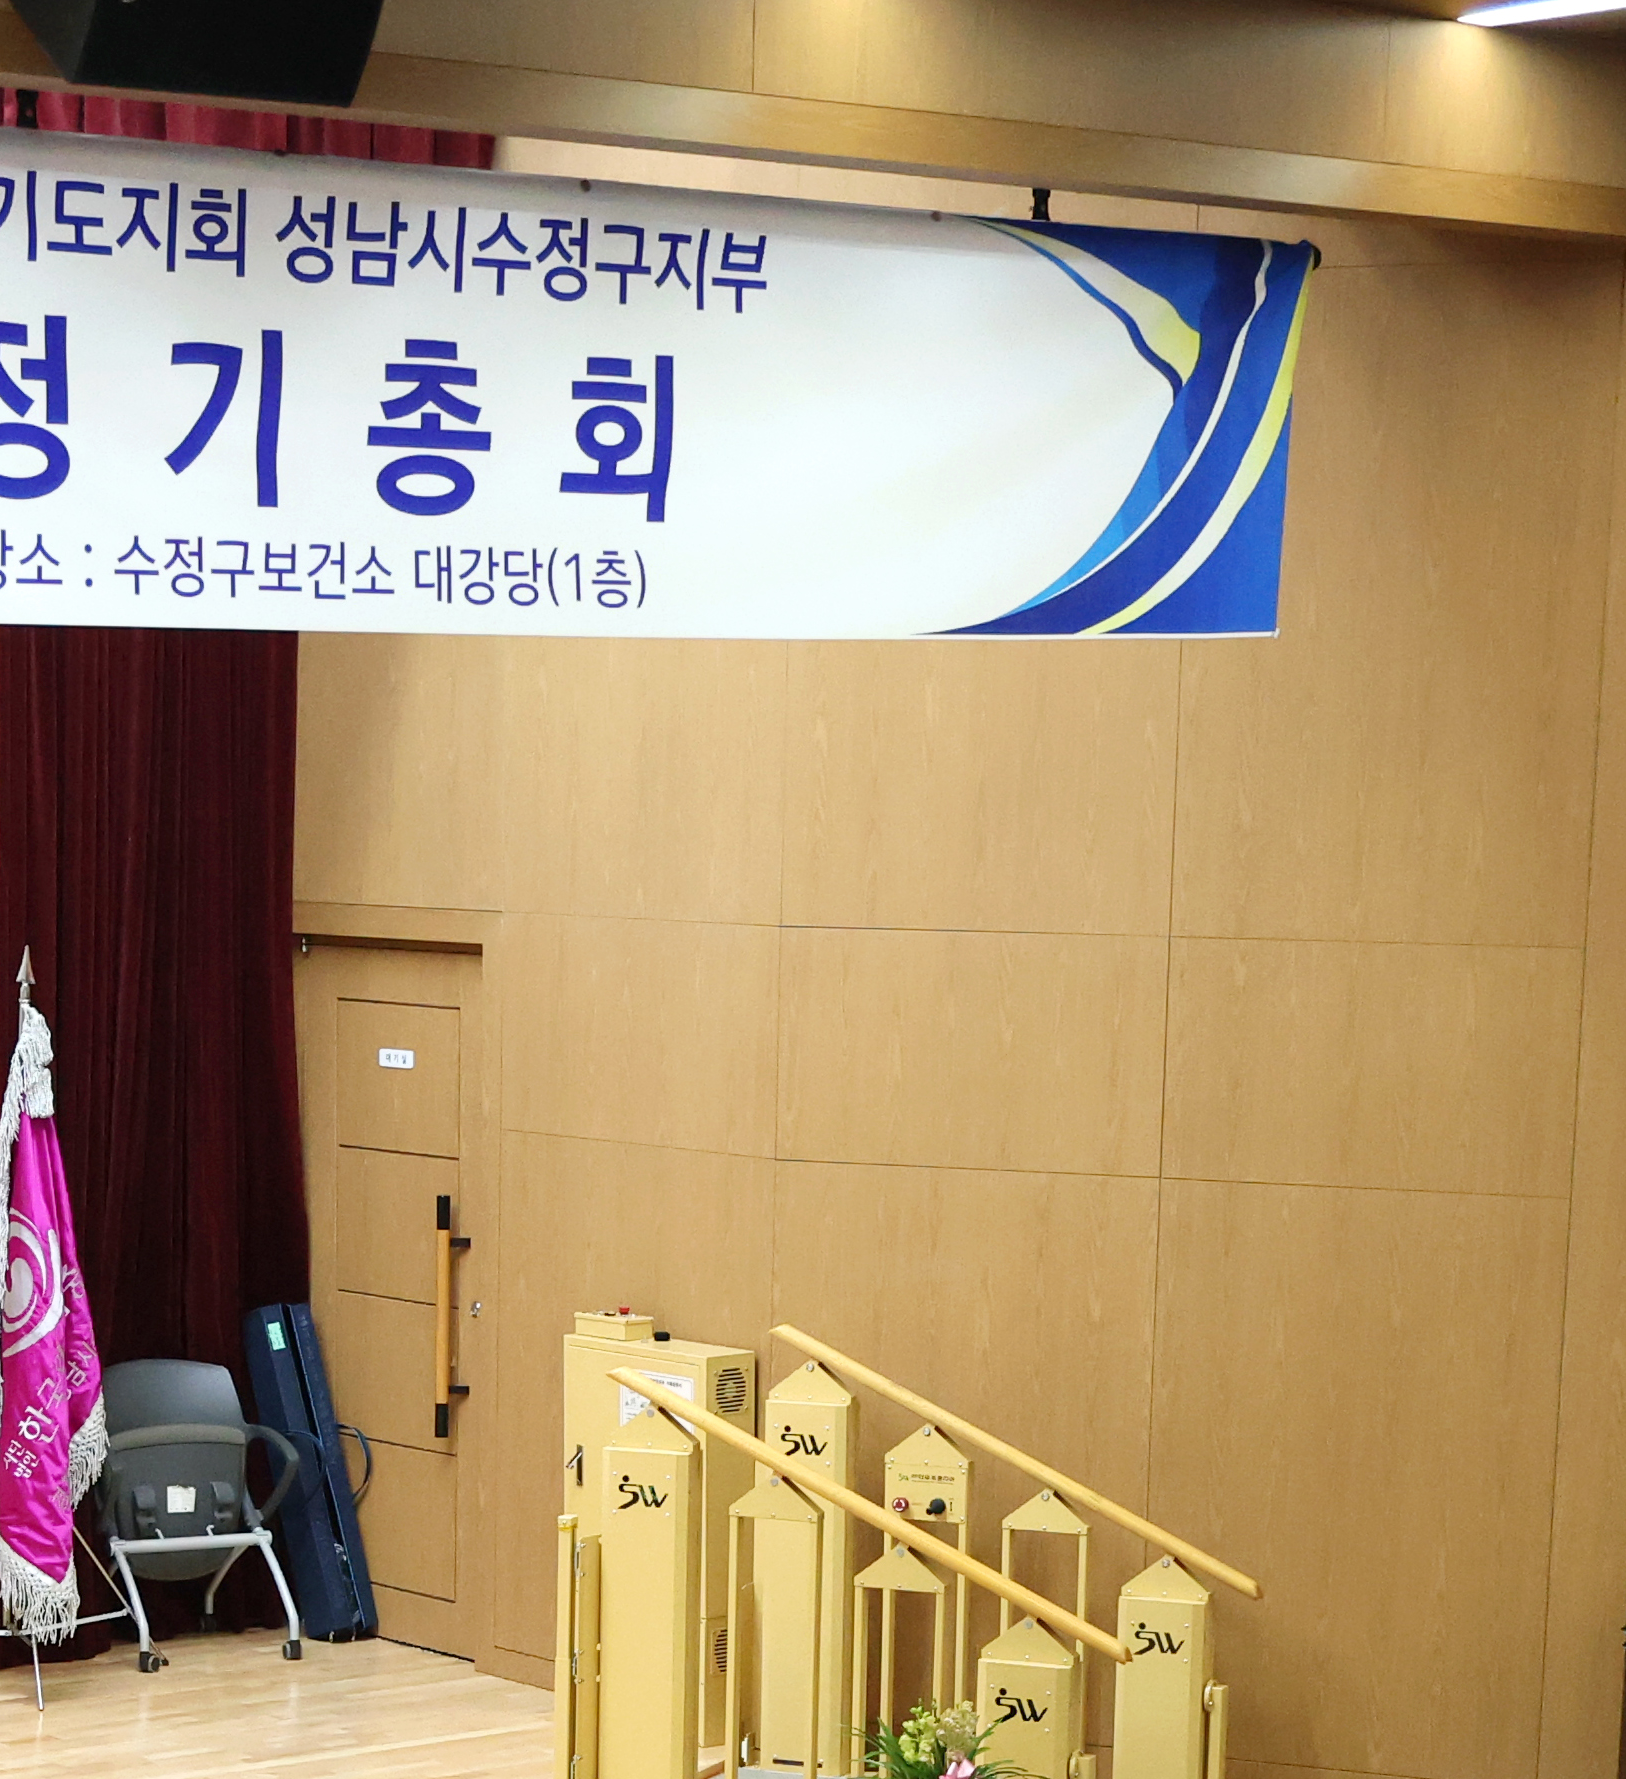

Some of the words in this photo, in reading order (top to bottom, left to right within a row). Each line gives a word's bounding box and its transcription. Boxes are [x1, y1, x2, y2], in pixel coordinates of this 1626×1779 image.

[275, 195, 768, 313] 성남시수정구지부
[112, 534, 396, 602] 수정구보건소
[414, 544, 648, 609] 대강당(1층)
